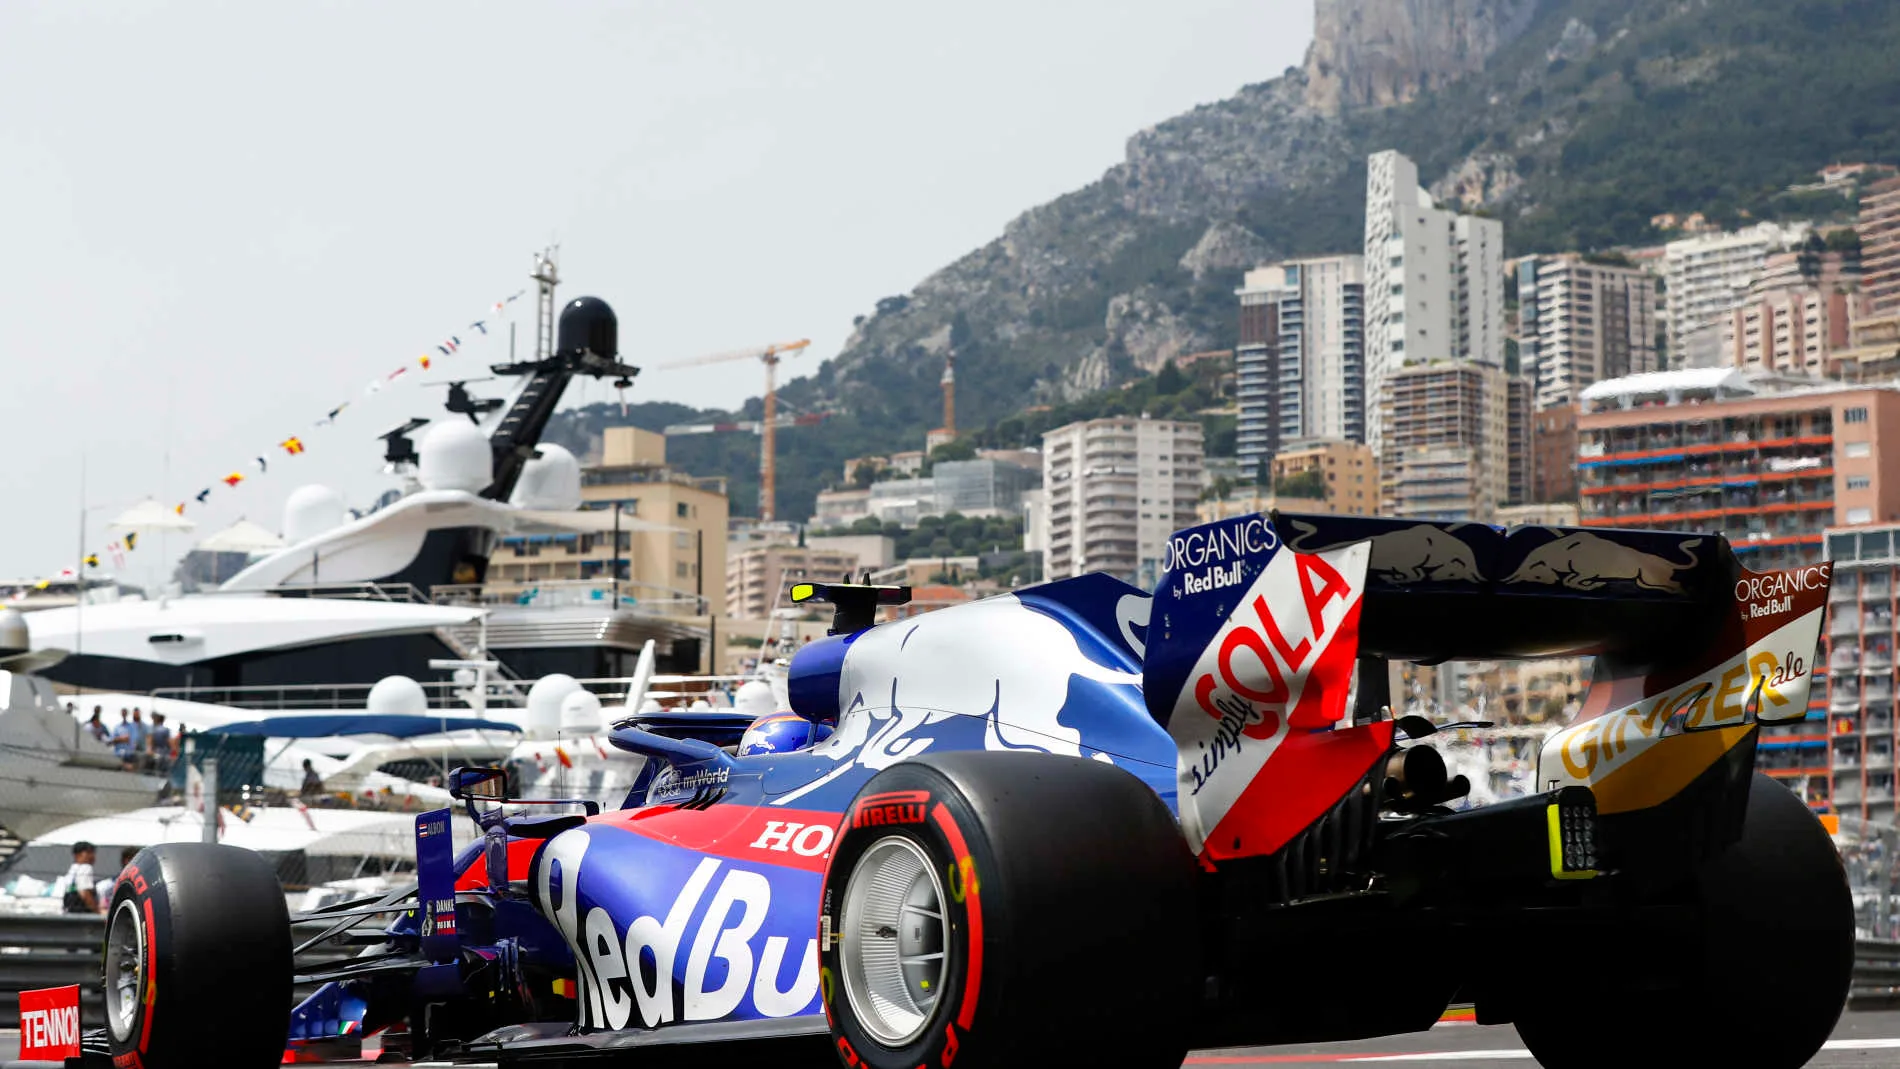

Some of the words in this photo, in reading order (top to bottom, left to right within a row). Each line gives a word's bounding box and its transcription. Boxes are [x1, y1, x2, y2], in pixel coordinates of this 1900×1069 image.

[1163, 518, 1277, 573] ORGANICS
[1173, 585, 1182, 599] by
[1184, 567, 1211, 595] Red
[1214, 561, 1242, 589] Bull
[1735, 567, 1830, 601] ORGANICS
[1750, 600, 1770, 618] Red
[1771, 595, 1792, 614] Bull
[1195, 553, 1351, 740] COLA
[1770, 651, 1807, 688] ale
[1561, 651, 1789, 780] GINGER
[1190, 694, 1261, 796] simply
[683, 766, 731, 790] myWorld
[853, 790, 930, 829] PIRELLI
[750, 821, 834, 858] HO
[436, 899, 455, 913] DANKE
[538, 829, 722, 1030] Red
[684, 868, 826, 1021] Bu
[21, 1006, 79, 1048] TENNOR
